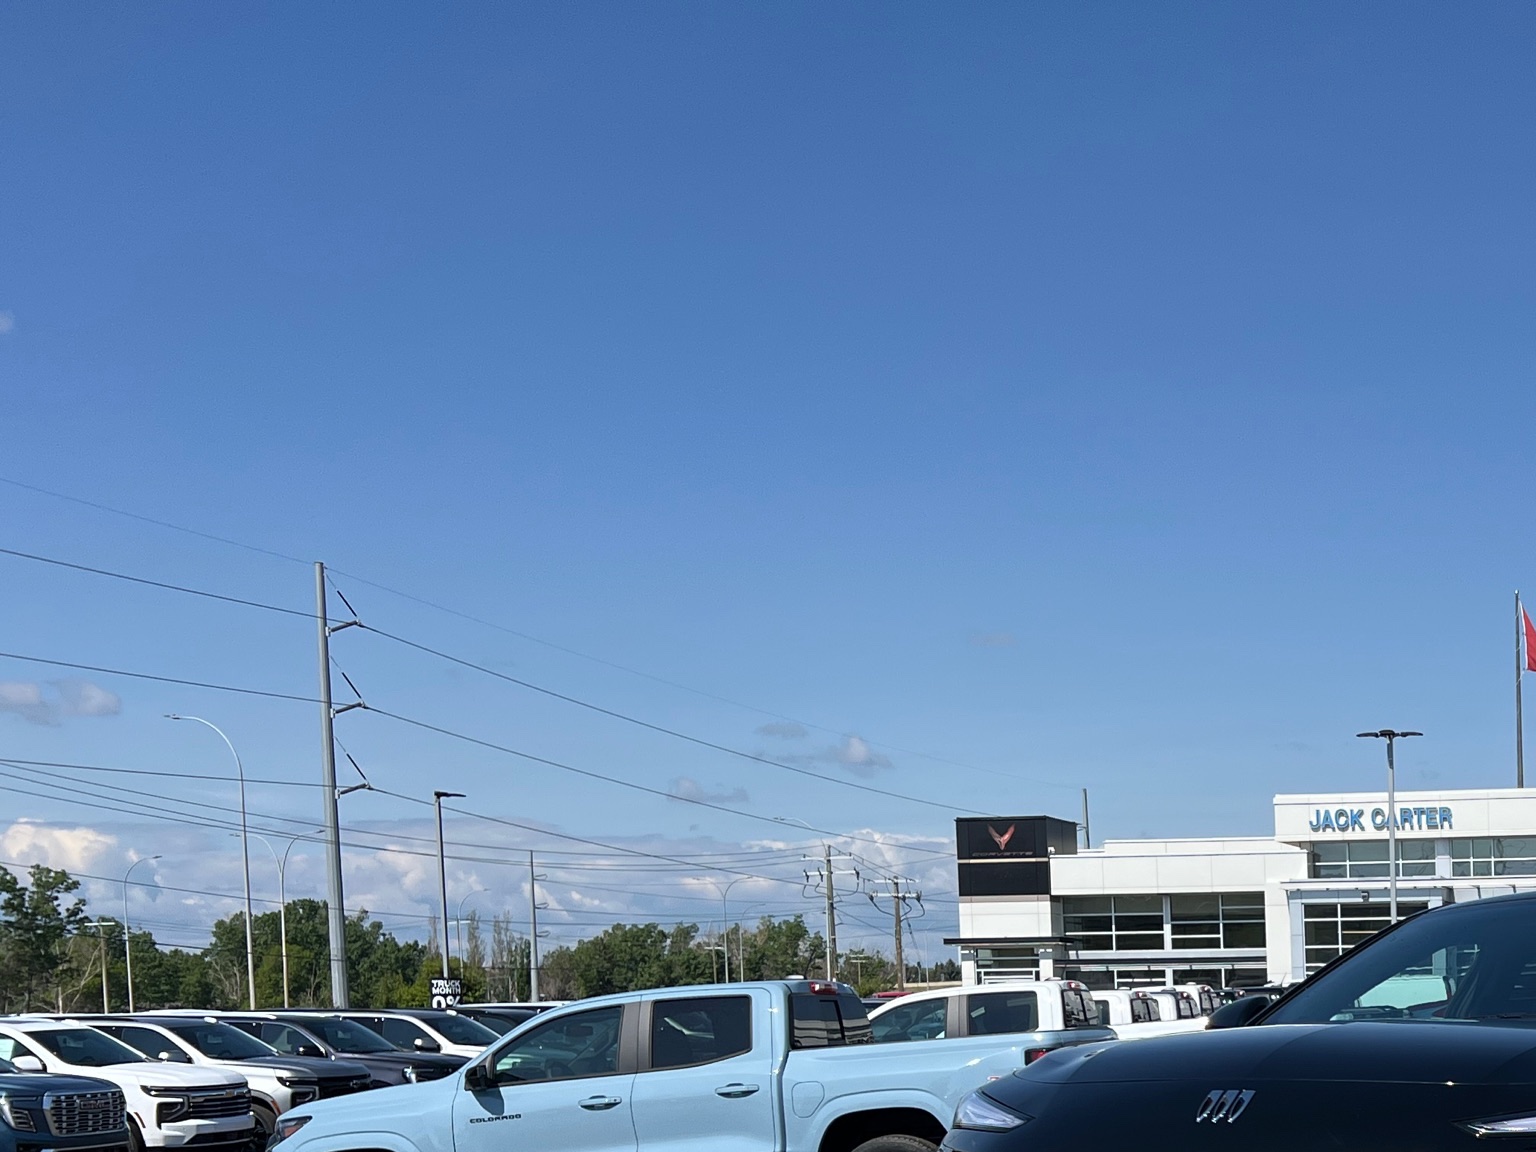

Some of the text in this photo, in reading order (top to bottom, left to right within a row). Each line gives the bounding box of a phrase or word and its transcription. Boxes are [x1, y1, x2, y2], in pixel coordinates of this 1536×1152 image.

[1309, 806, 1453, 832] JACK CARTER
[972, 850, 1034, 858] CORVETTE
[431, 980, 461, 988] TRUCK
[431, 987, 461, 995] MONTH
[469, 1113, 522, 1124] COLORADO
